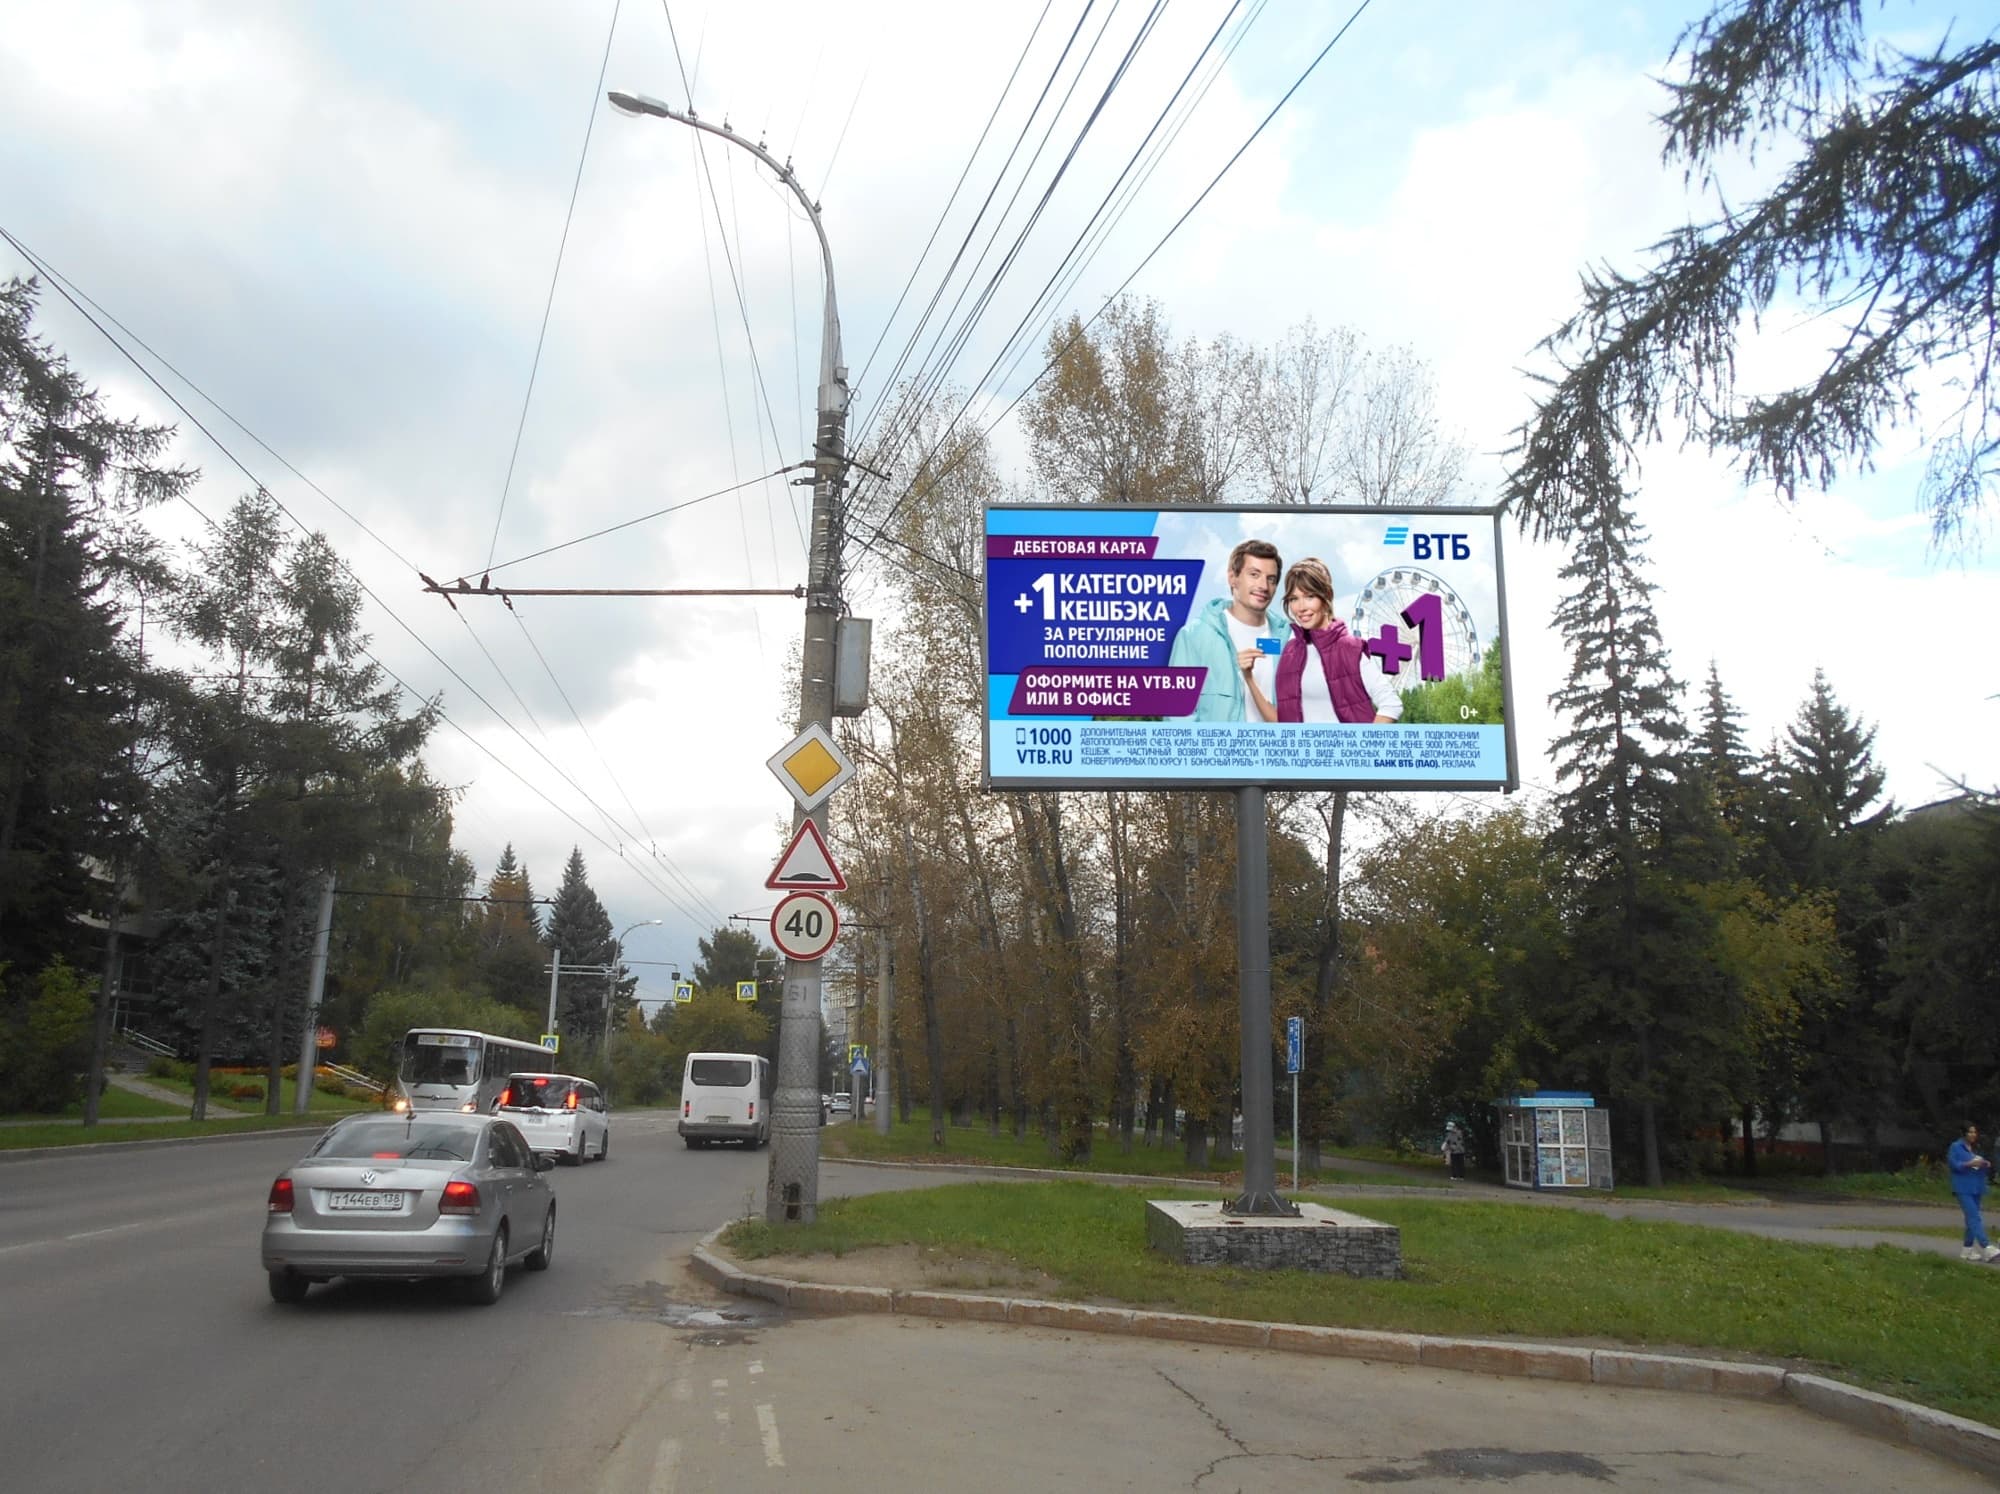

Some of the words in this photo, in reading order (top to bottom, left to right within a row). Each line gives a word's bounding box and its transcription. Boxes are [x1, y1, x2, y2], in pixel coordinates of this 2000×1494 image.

[1013, 540, 1096, 555] ДЕБЕТОВАЯ
[1100, 541, 1147, 555] КАРТА
[1412, 533, 1471, 561] ВТБ
[1060, 573, 1187, 595] КАТЕГОРИЯ
[1014, 573, 1056, 621] +1
[1060, 600, 1171, 621] КЕШБЭКА
[1044, 627, 1065, 641] ЗА
[1068, 627, 1166, 642] РЕГУЛЯРНОЕ
[1367, 593, 1446, 682] +1
[1044, 644, 1150, 659] ПОПОЛНЕНИЕ
[1025, 674, 1113, 690] ОФОРМИТЕ
[1116, 675, 1139, 689] НА
[1142, 675, 1196, 690] VTB.RU
[1026, 692, 1060, 706] ИЛИ
[1063, 692, 1073, 706] В
[1076, 692, 1132, 706] ОФИСЕ
[1460, 704, 1479, 720] 0+
[1029, 728, 1072, 745] 1000
[1080, 728, 1147, 737] ДОПОЛНИТЕЛЬНАЯ
[1152, 728, 1192, 737] КАТЕГОРИЯ
[1197, 729, 1232, 738] КЕШБЭКА
[1237, 729, 1275, 739] ДОСТУПНА
[1281, 729, 1296, 739] ДЛЯ
[1301, 730, 1357, 739] НЕЗАРПЛАТНЫХ
[1362, 730, 1400, 739] КЛИЕНТОВ
[1405, 730, 1420, 739] ПРИ
[1424, 731, 1480, 740] ПОДКЛЮЧЕНИИ
[1080, 737, 1147, 746] АВТОПОПОЛНЕНИЯ
[1149, 738, 1172, 747] СЧЕТА
[1174, 738, 1199, 747] КАРТЫ
[1201, 738, 1215, 747] ВТБ
[1217, 738, 1227, 747] ИЗ
[1229, 739, 1257, 748] ДРУГИХ
[1259, 739, 1288, 748] БАНКОВ
[1290, 739, 1296, 748] В
[1297, 739, 1312, 748] ВТБ
[1313, 738, 1344, 748] ОНЛАЙН
[1346, 740, 1358, 749] НА
[1360, 740, 1386, 749] СУММУ
[1388, 740, 1398, 749] НЕ
[1400, 740, 1424, 749] МЕНЕЕ
[1425, 740, 1443, 749] 9000
[1016, 749, 1073, 765] VTB.RU
[1080, 747, 1111, 756] КЕШБЭК
[1127, 747, 1172, 756] ЧАСТИЧНЫЙ
[1177, 748, 1208, 757] ВОЗВРАТ
[1213, 748, 1259, 757] СТОИМОСТИ
[1264, 749, 1299, 758] ПОКУПКИ
[1305, 749, 1310, 758] В
[1316, 749, 1335, 758] ВИДЕ
[1341, 749, 1380, 758] БОНУСНЫХ
[1420, 750, 1481, 759] АВТОМАТИЧЕСКИ
[1080, 757, 1145, 766] КОНВЕРТИРУЕМЫХ
[1147, 757, 1158, 766] ПО
[1159, 757, 1182, 766] КУРСУ
[1191, 756, 1230, 767] БОНУСНЫЙ
[1232, 758, 1254, 767] РУБЛЬ
[1291, 758, 1333, 768] ПОДРОБНЕЕ
[1334, 759, 1345, 768] НА
[1374, 759, 1397, 768] БАНК
[1398, 759, 1414, 768] ВТБ
[1416, 759, 1440, 769] (ПАО).
[1442, 759, 1476, 768] РЕКЛАМА
[784, 909, 823, 938] 40
